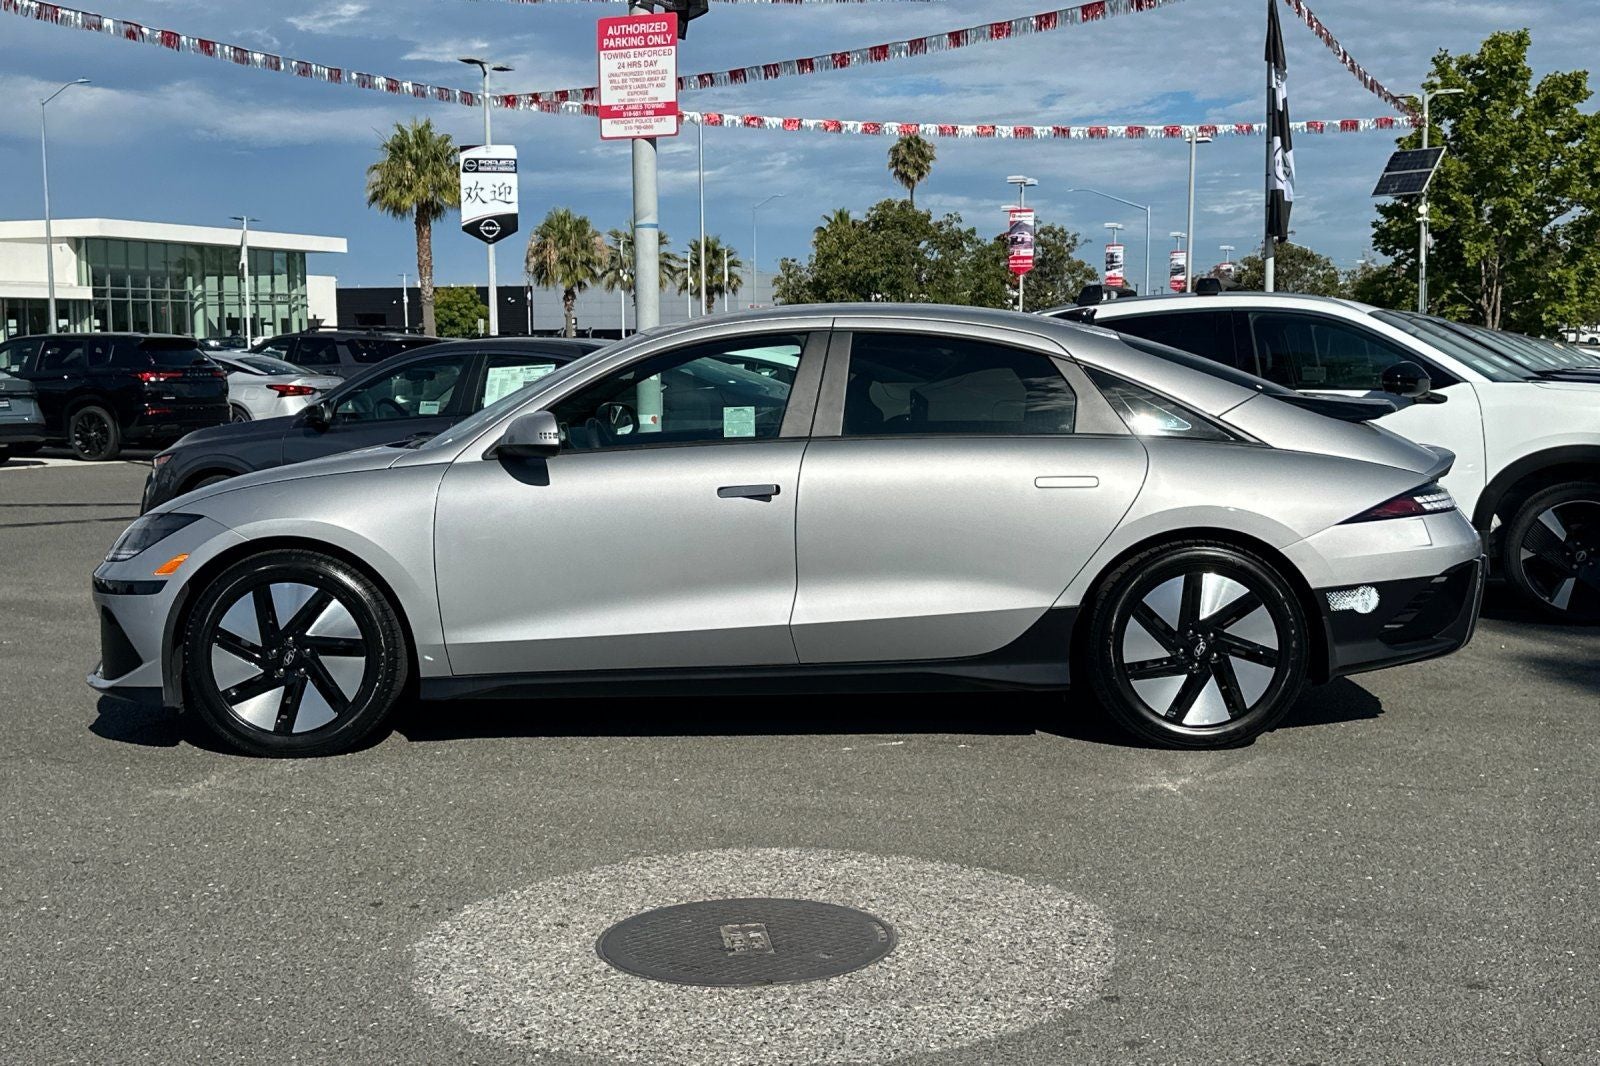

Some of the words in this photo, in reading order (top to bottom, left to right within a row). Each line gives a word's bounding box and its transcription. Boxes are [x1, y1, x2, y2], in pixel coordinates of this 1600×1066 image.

[607, 21, 668, 36] AUTHORIZED
[603, 36, 645, 49] PARKING
[647, 33, 673, 46] ONLY
[603, 51, 632, 60] TOWING
[633, 48, 673, 58] ENFORCED
[617, 62, 626, 70] 24
[627, 60, 642, 69] HRS
[643, 60, 658, 68] DAY
[608, 70, 645, 78] UNAUTHORIZED
[463, 180, 515, 205] 欢迎
